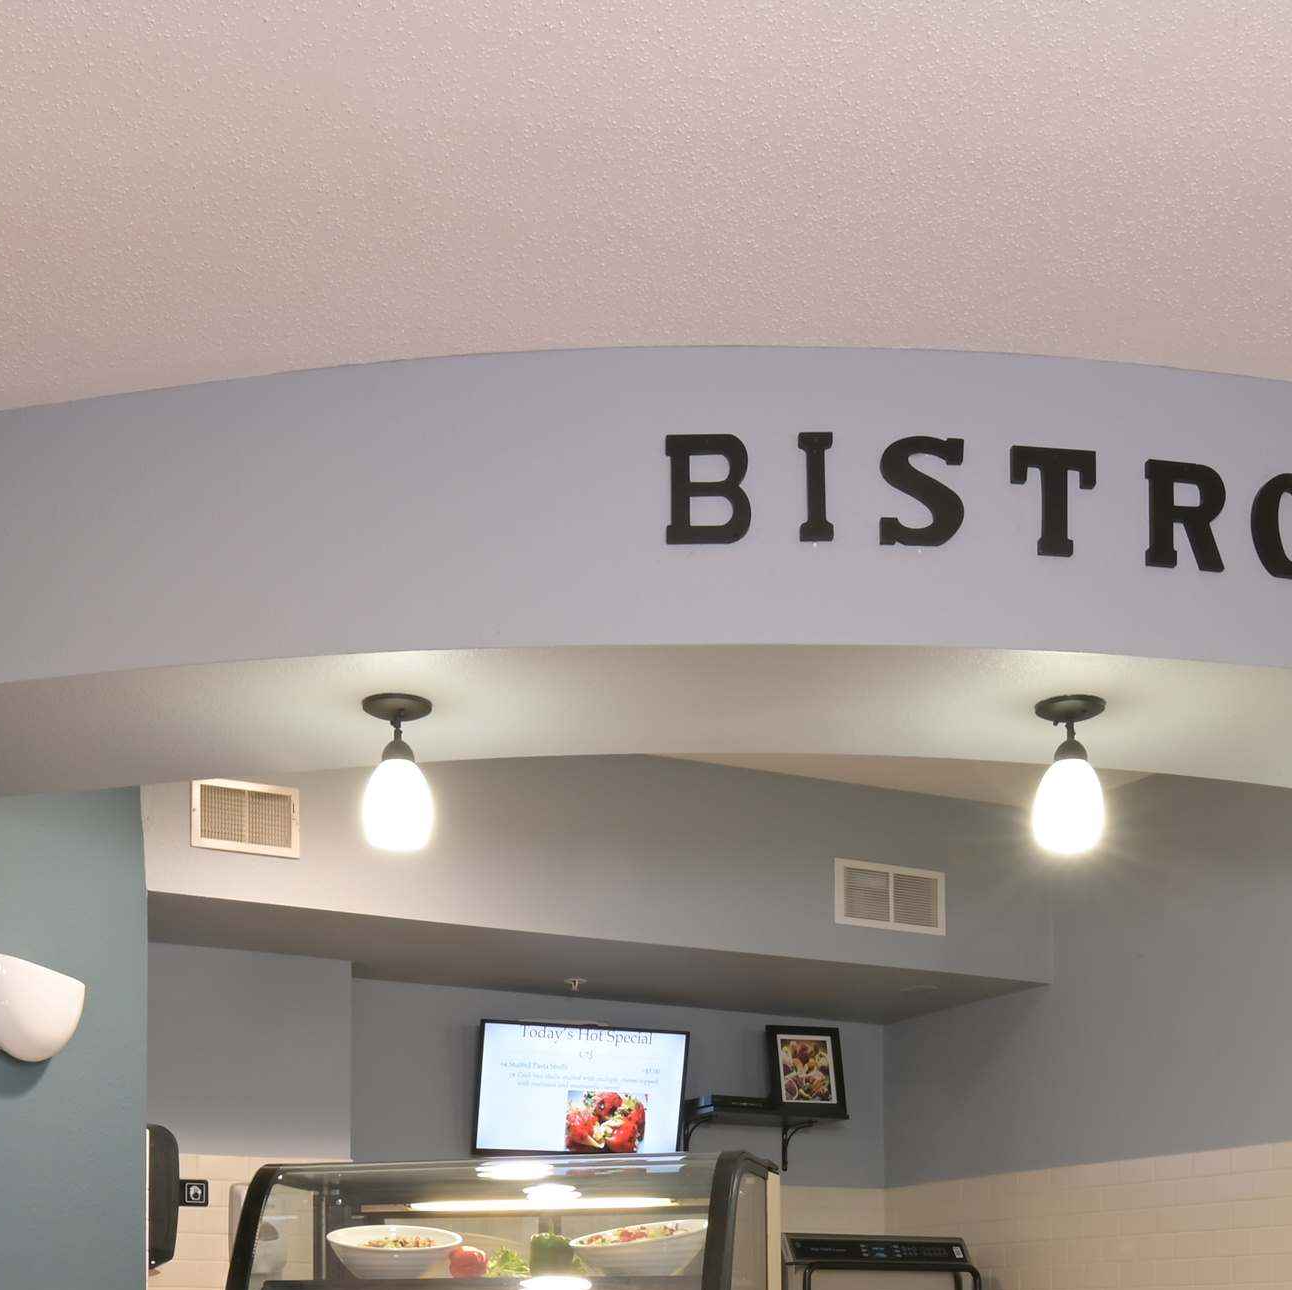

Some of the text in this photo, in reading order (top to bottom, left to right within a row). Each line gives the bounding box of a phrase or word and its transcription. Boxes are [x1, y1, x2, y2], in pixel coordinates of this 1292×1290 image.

[521, 1025, 653, 1047] Today's Hot Special
